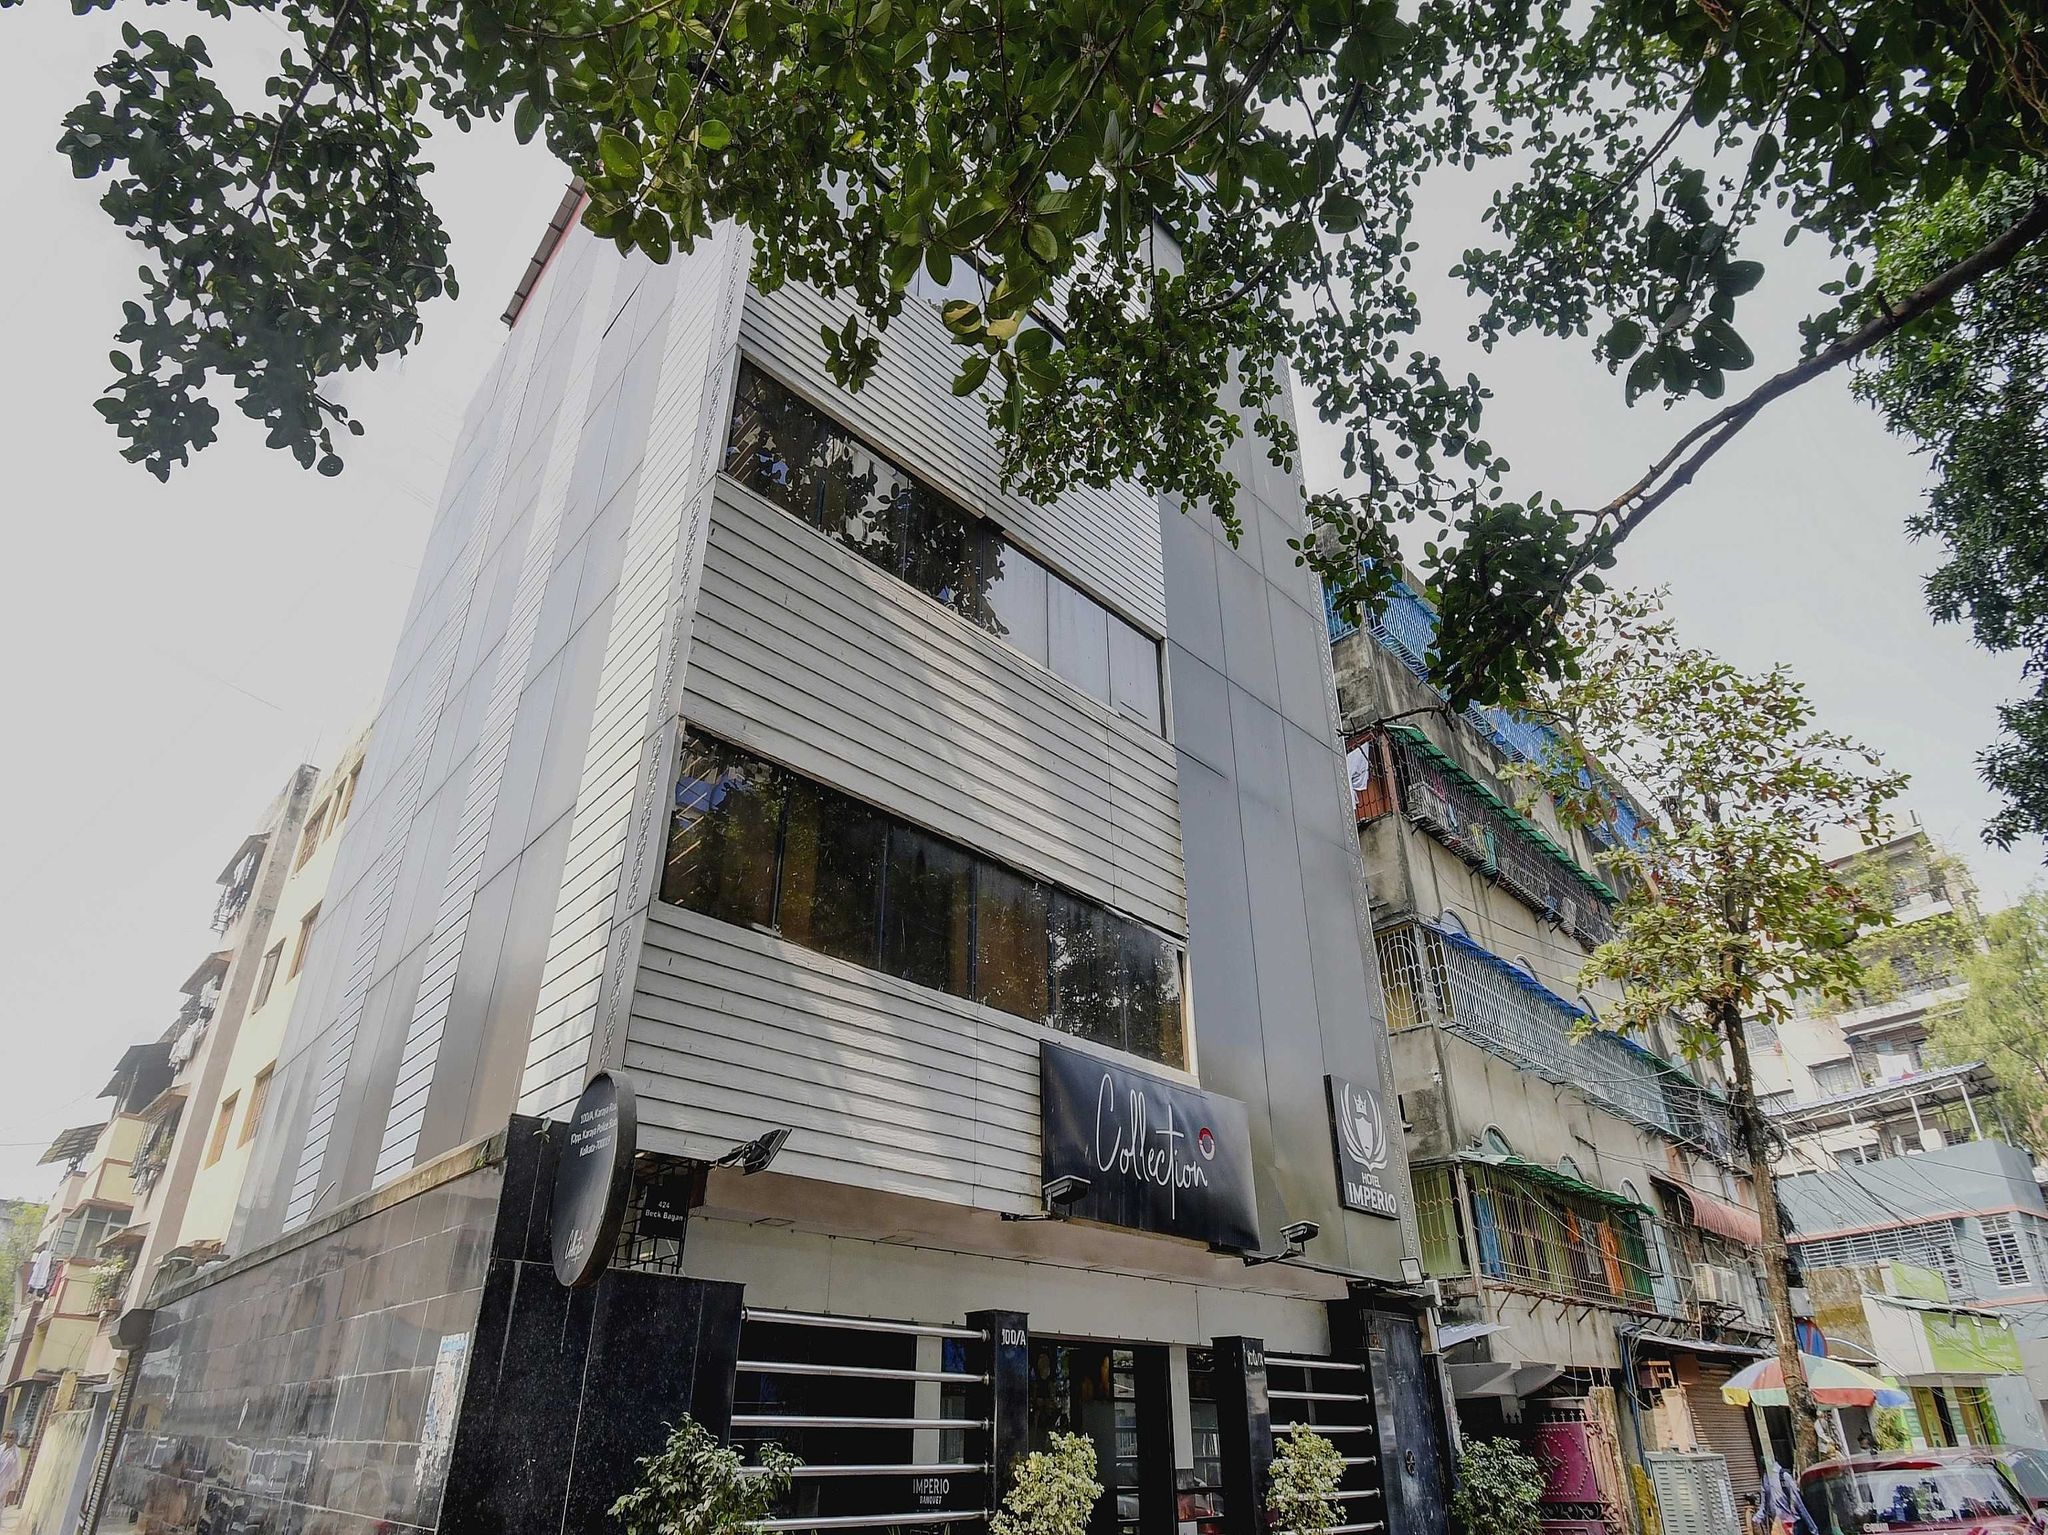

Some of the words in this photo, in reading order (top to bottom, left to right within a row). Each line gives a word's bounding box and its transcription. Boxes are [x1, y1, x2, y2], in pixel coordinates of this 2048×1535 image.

[1096, 1073, 1208, 1220] Collection
[1361, 1172, 1381, 1188] HOTEL
[658, 1200, 670, 1209] 424
[1347, 1181, 1397, 1214] IMPERIO
[645, 1209, 661, 1218] Beck
[663, 1211, 684, 1222] Bagan
[1001, 1328, 1026, 1346] 100/A
[912, 1478, 950, 1494] IMPERIO
